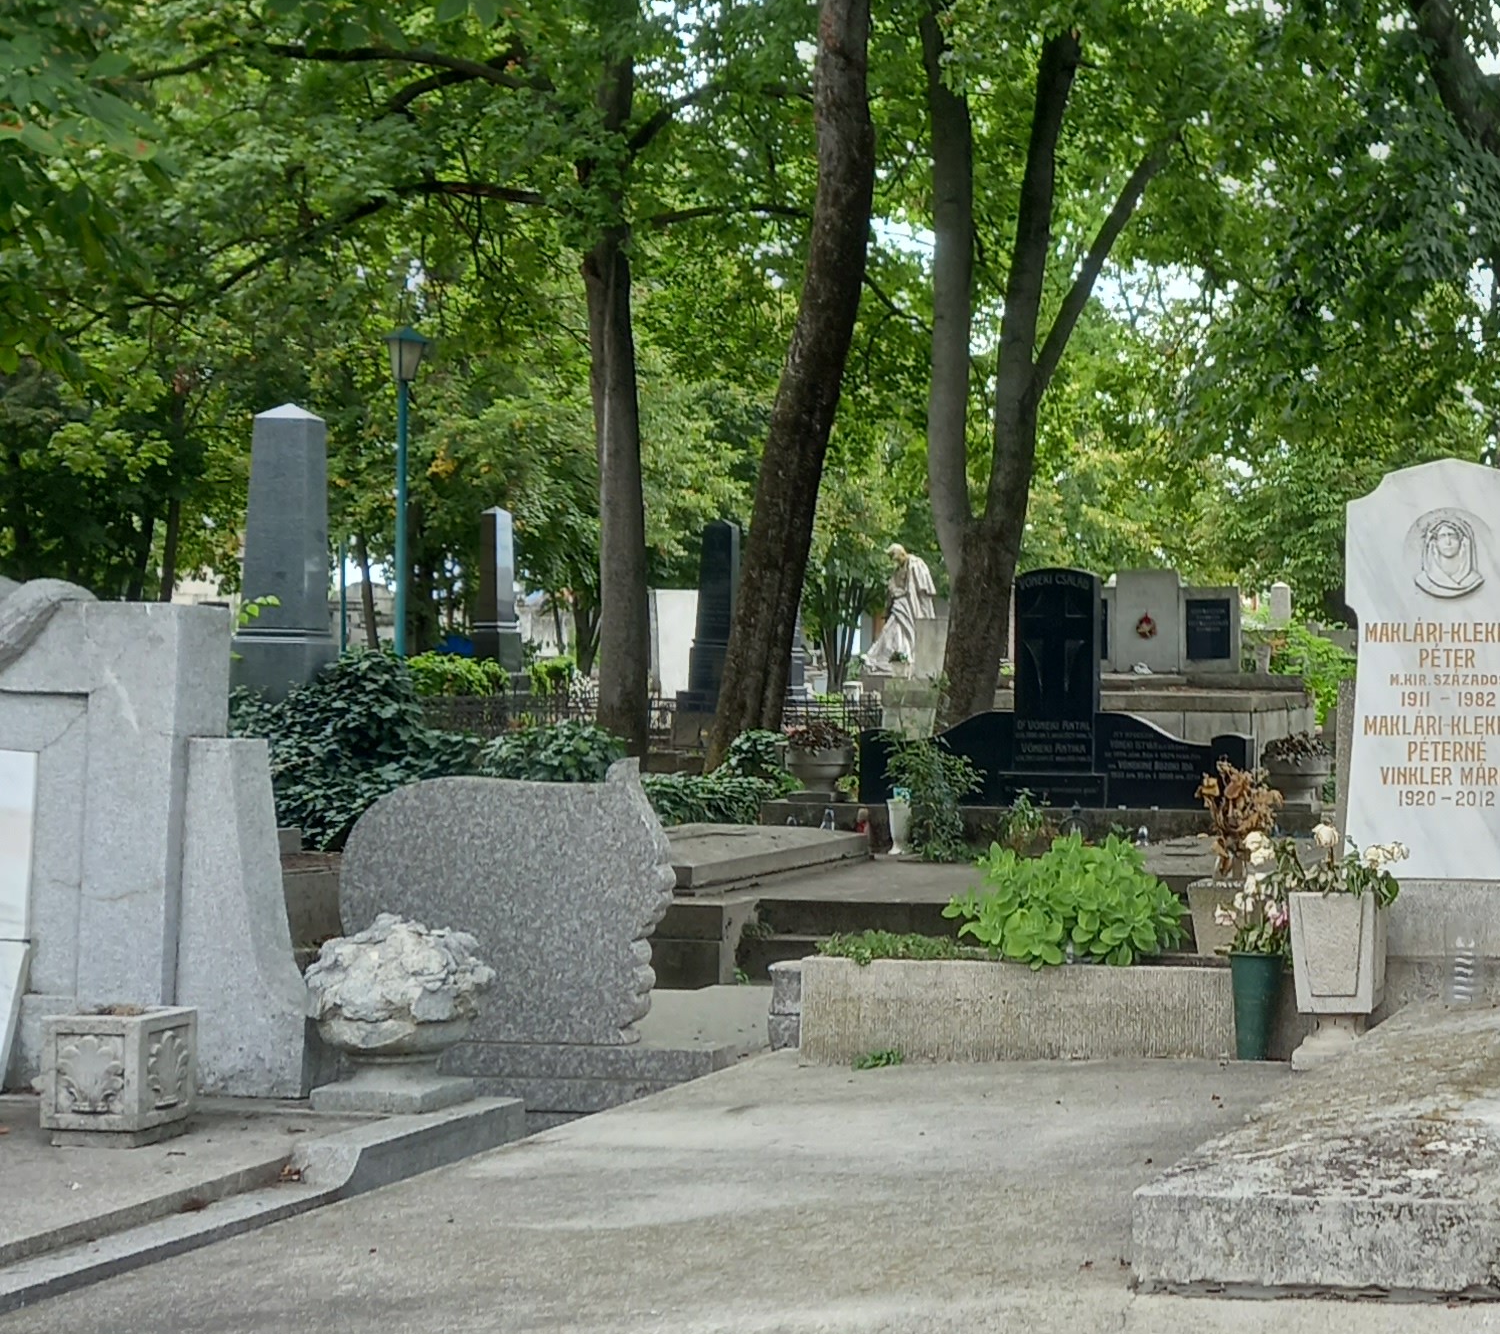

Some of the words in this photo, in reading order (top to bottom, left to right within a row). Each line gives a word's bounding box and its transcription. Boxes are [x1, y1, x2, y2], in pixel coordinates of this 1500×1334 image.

[1419, 643, 1475, 668] PÉTER
[1401, 691, 1430, 707] 1911
[1458, 691, 1496, 707] 1982
[1407, 736, 1487, 762] PÉTERNÉ
[1380, 767, 1452, 786] VINKLER
[1399, 791, 1436, 806] 1920
[1455, 791, 1495, 806] 2012
